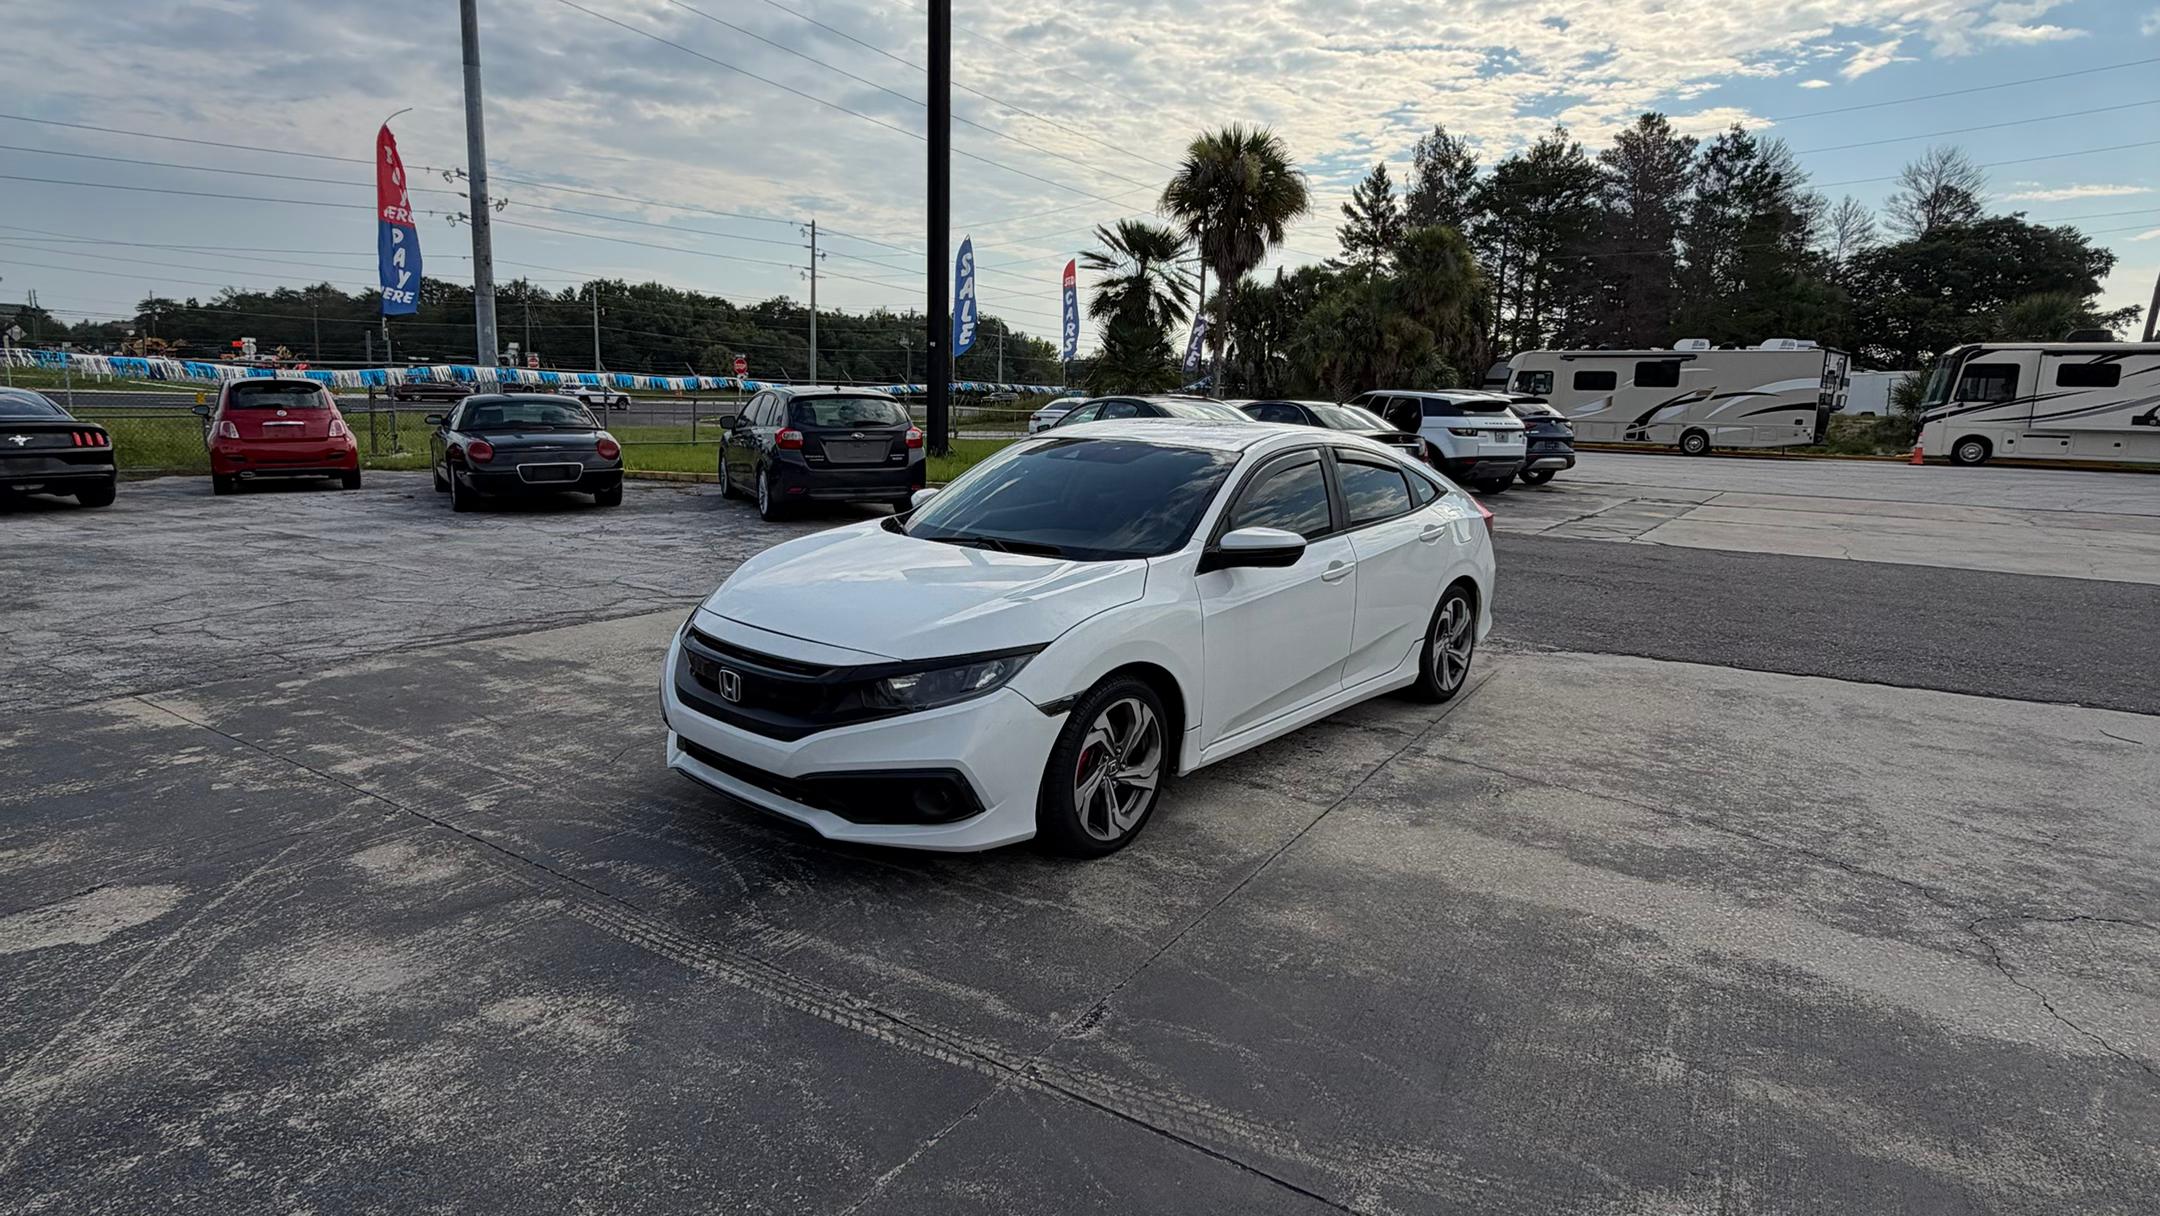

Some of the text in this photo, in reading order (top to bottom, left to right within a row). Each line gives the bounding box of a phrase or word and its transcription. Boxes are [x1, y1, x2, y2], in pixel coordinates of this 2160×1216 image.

[392, 228, 412, 289] PAY
[381, 286, 415, 304] ERE
[959, 252, 975, 345] SALE
[1064, 290, 1076, 352] CARS
